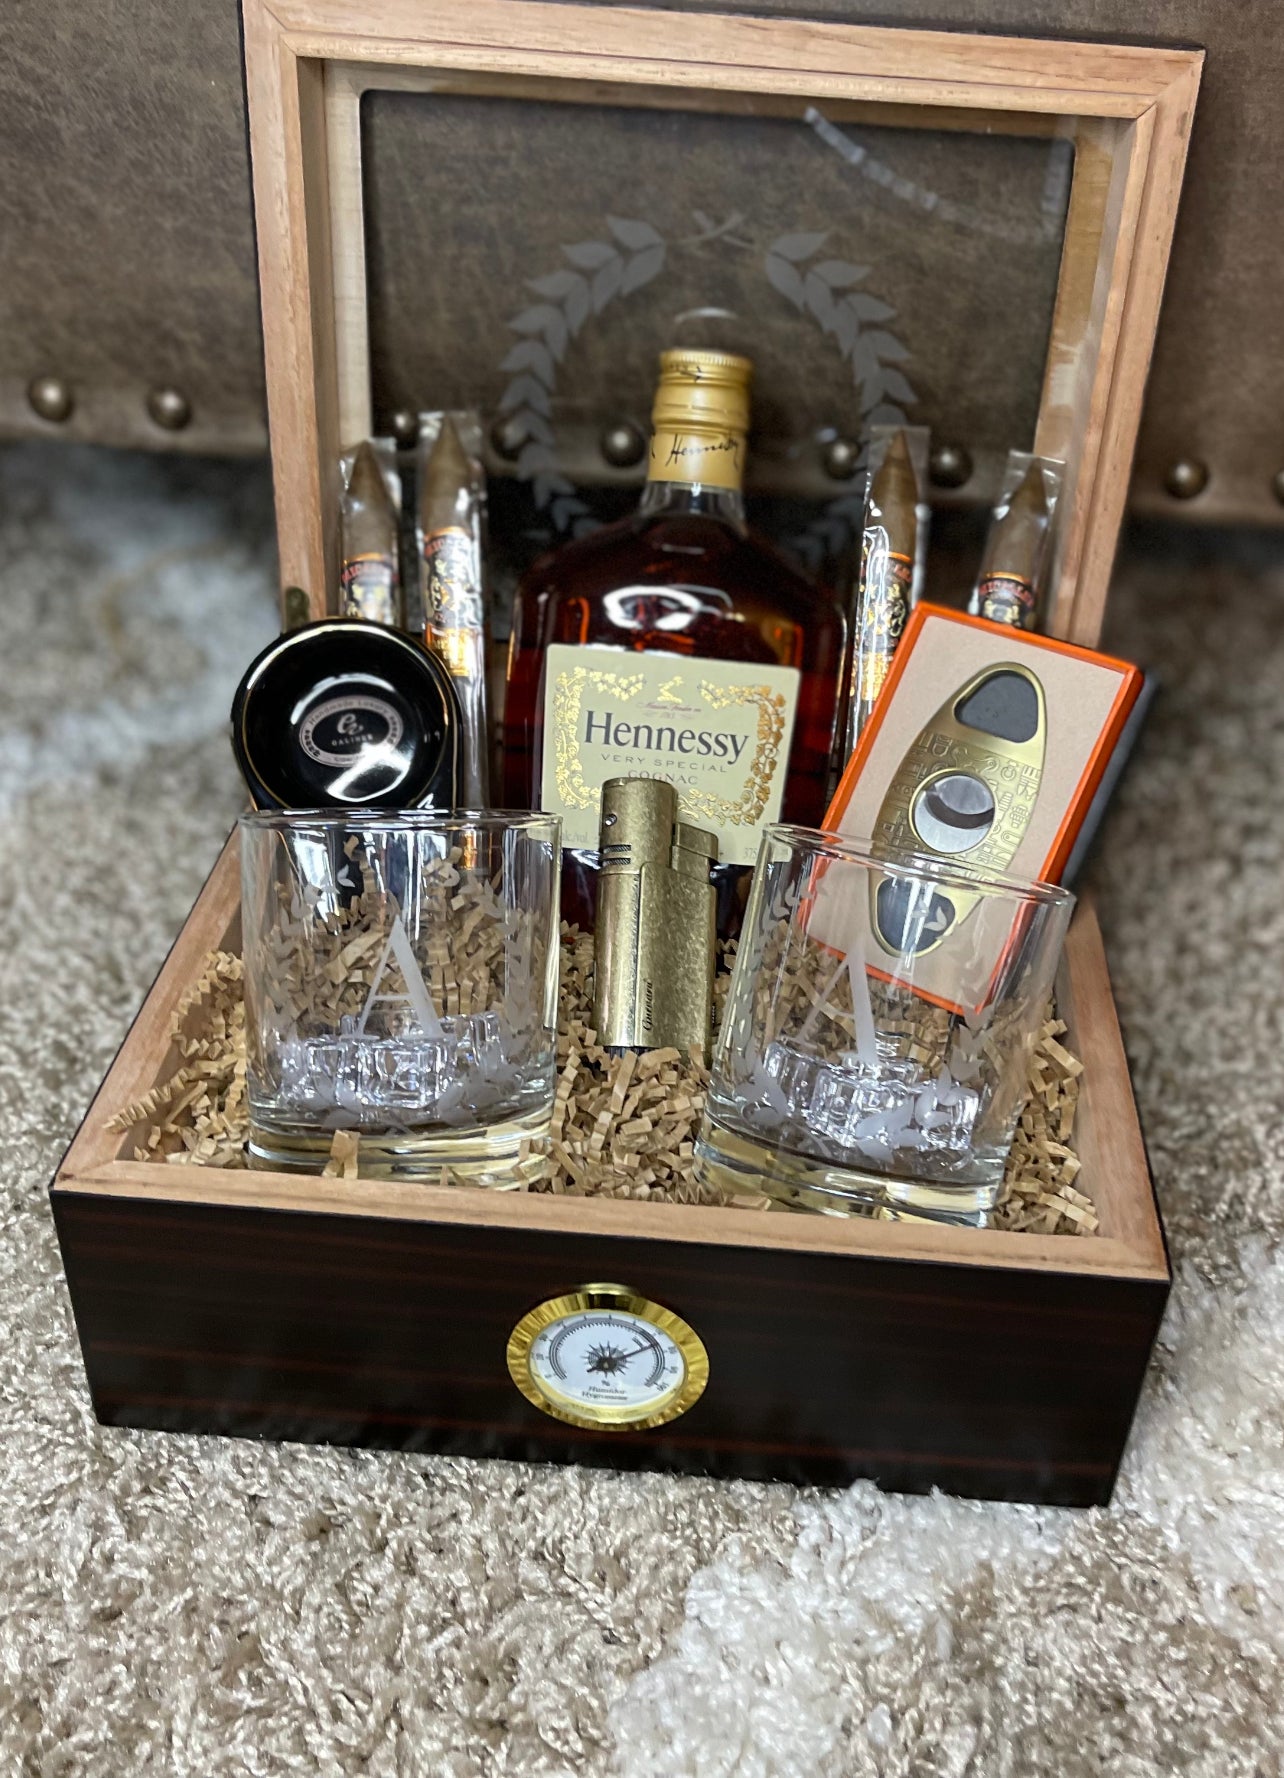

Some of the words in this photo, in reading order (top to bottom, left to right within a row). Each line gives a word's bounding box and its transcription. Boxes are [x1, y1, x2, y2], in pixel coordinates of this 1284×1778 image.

[585, 709, 750, 765] Hennessy
[601, 752, 646, 766] VERY
[654, 757, 727, 774] SPECIAL
[627, 769, 699, 786] COGNAC
[348, 913, 450, 1040] A
